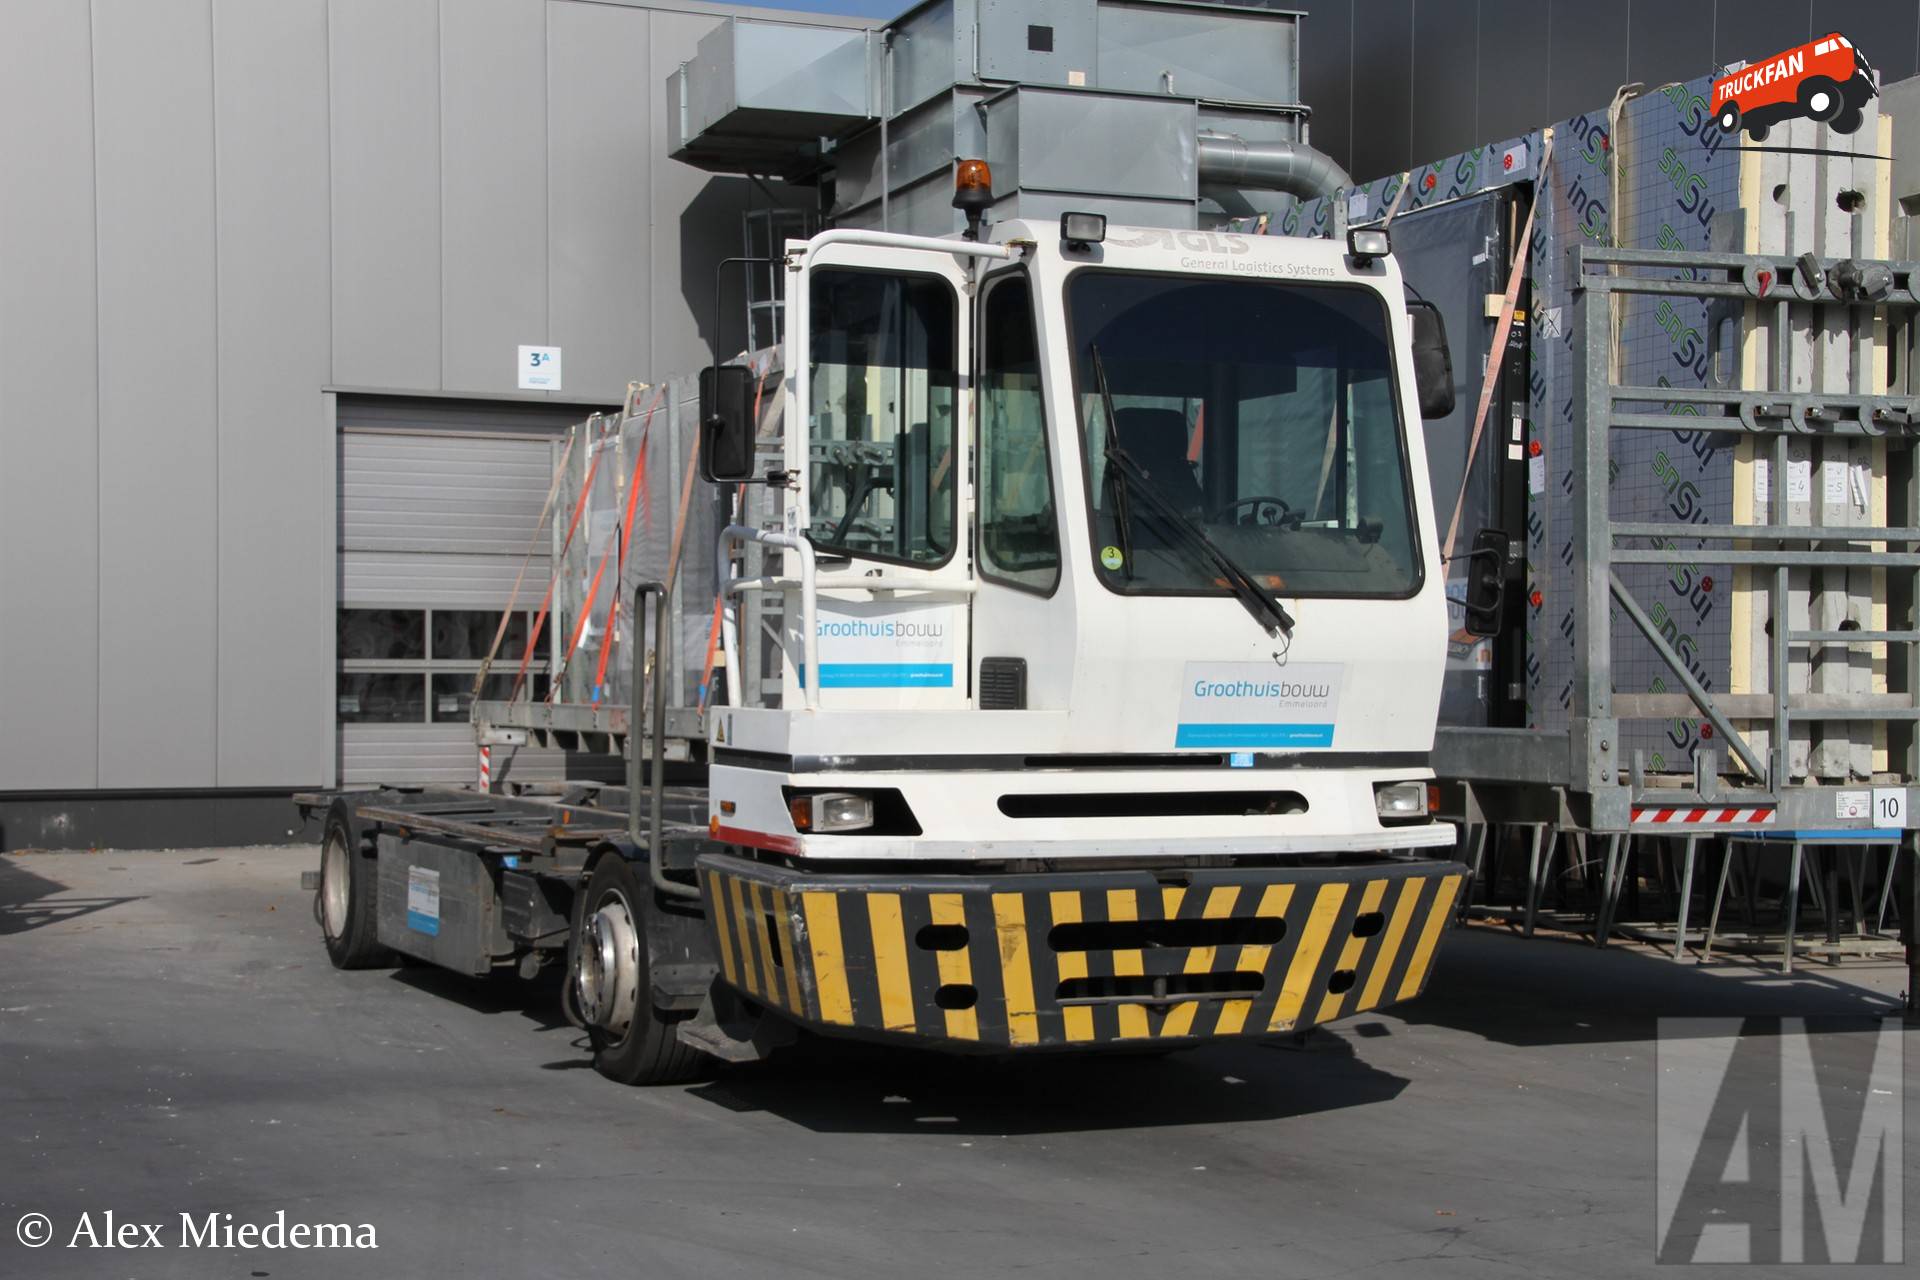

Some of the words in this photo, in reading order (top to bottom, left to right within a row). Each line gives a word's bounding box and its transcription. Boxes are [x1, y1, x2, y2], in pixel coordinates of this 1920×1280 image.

[1176, 231, 1250, 255] GLS
[1181, 256, 1228, 271] General
[1232, 260, 1284, 275] Logistics
[1287, 263, 1335, 277] Systems
[1107, 546, 1115, 558] 3
[1194, 680, 1330, 698] Groothuisbouw
[1880, 797, 1899, 818] 10
